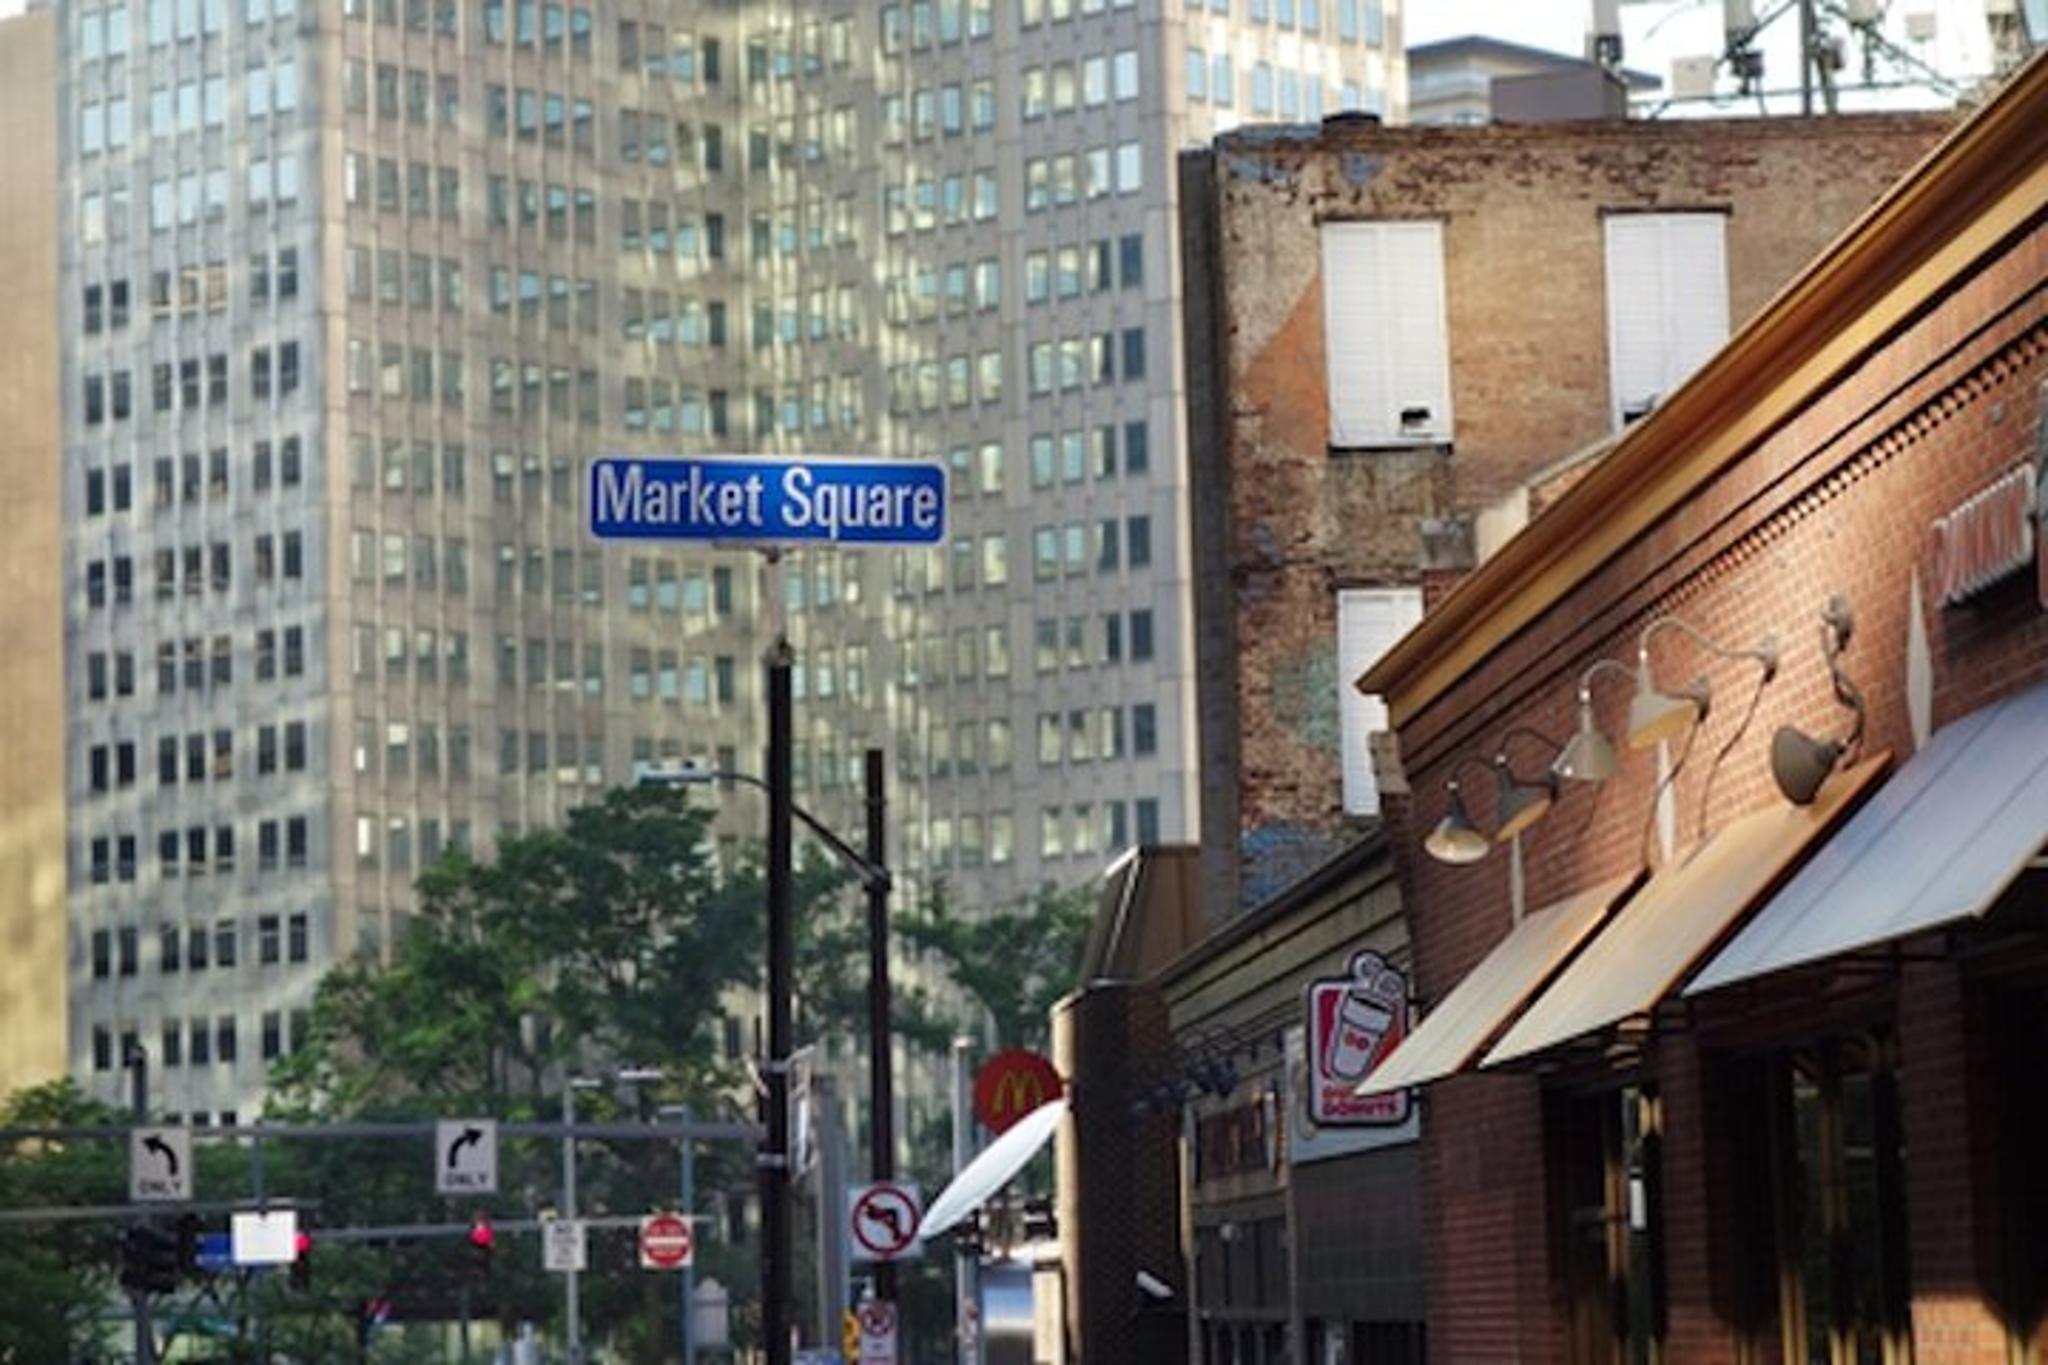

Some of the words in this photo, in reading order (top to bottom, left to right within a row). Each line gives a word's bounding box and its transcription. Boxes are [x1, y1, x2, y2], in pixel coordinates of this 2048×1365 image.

[598, 462, 763, 527] Market
[780, 465, 937, 540] Square
[1321, 1101, 1397, 1116] DONUTS
[138, 1177, 182, 1195] ONLY
[445, 1172, 488, 1188] ONLY
